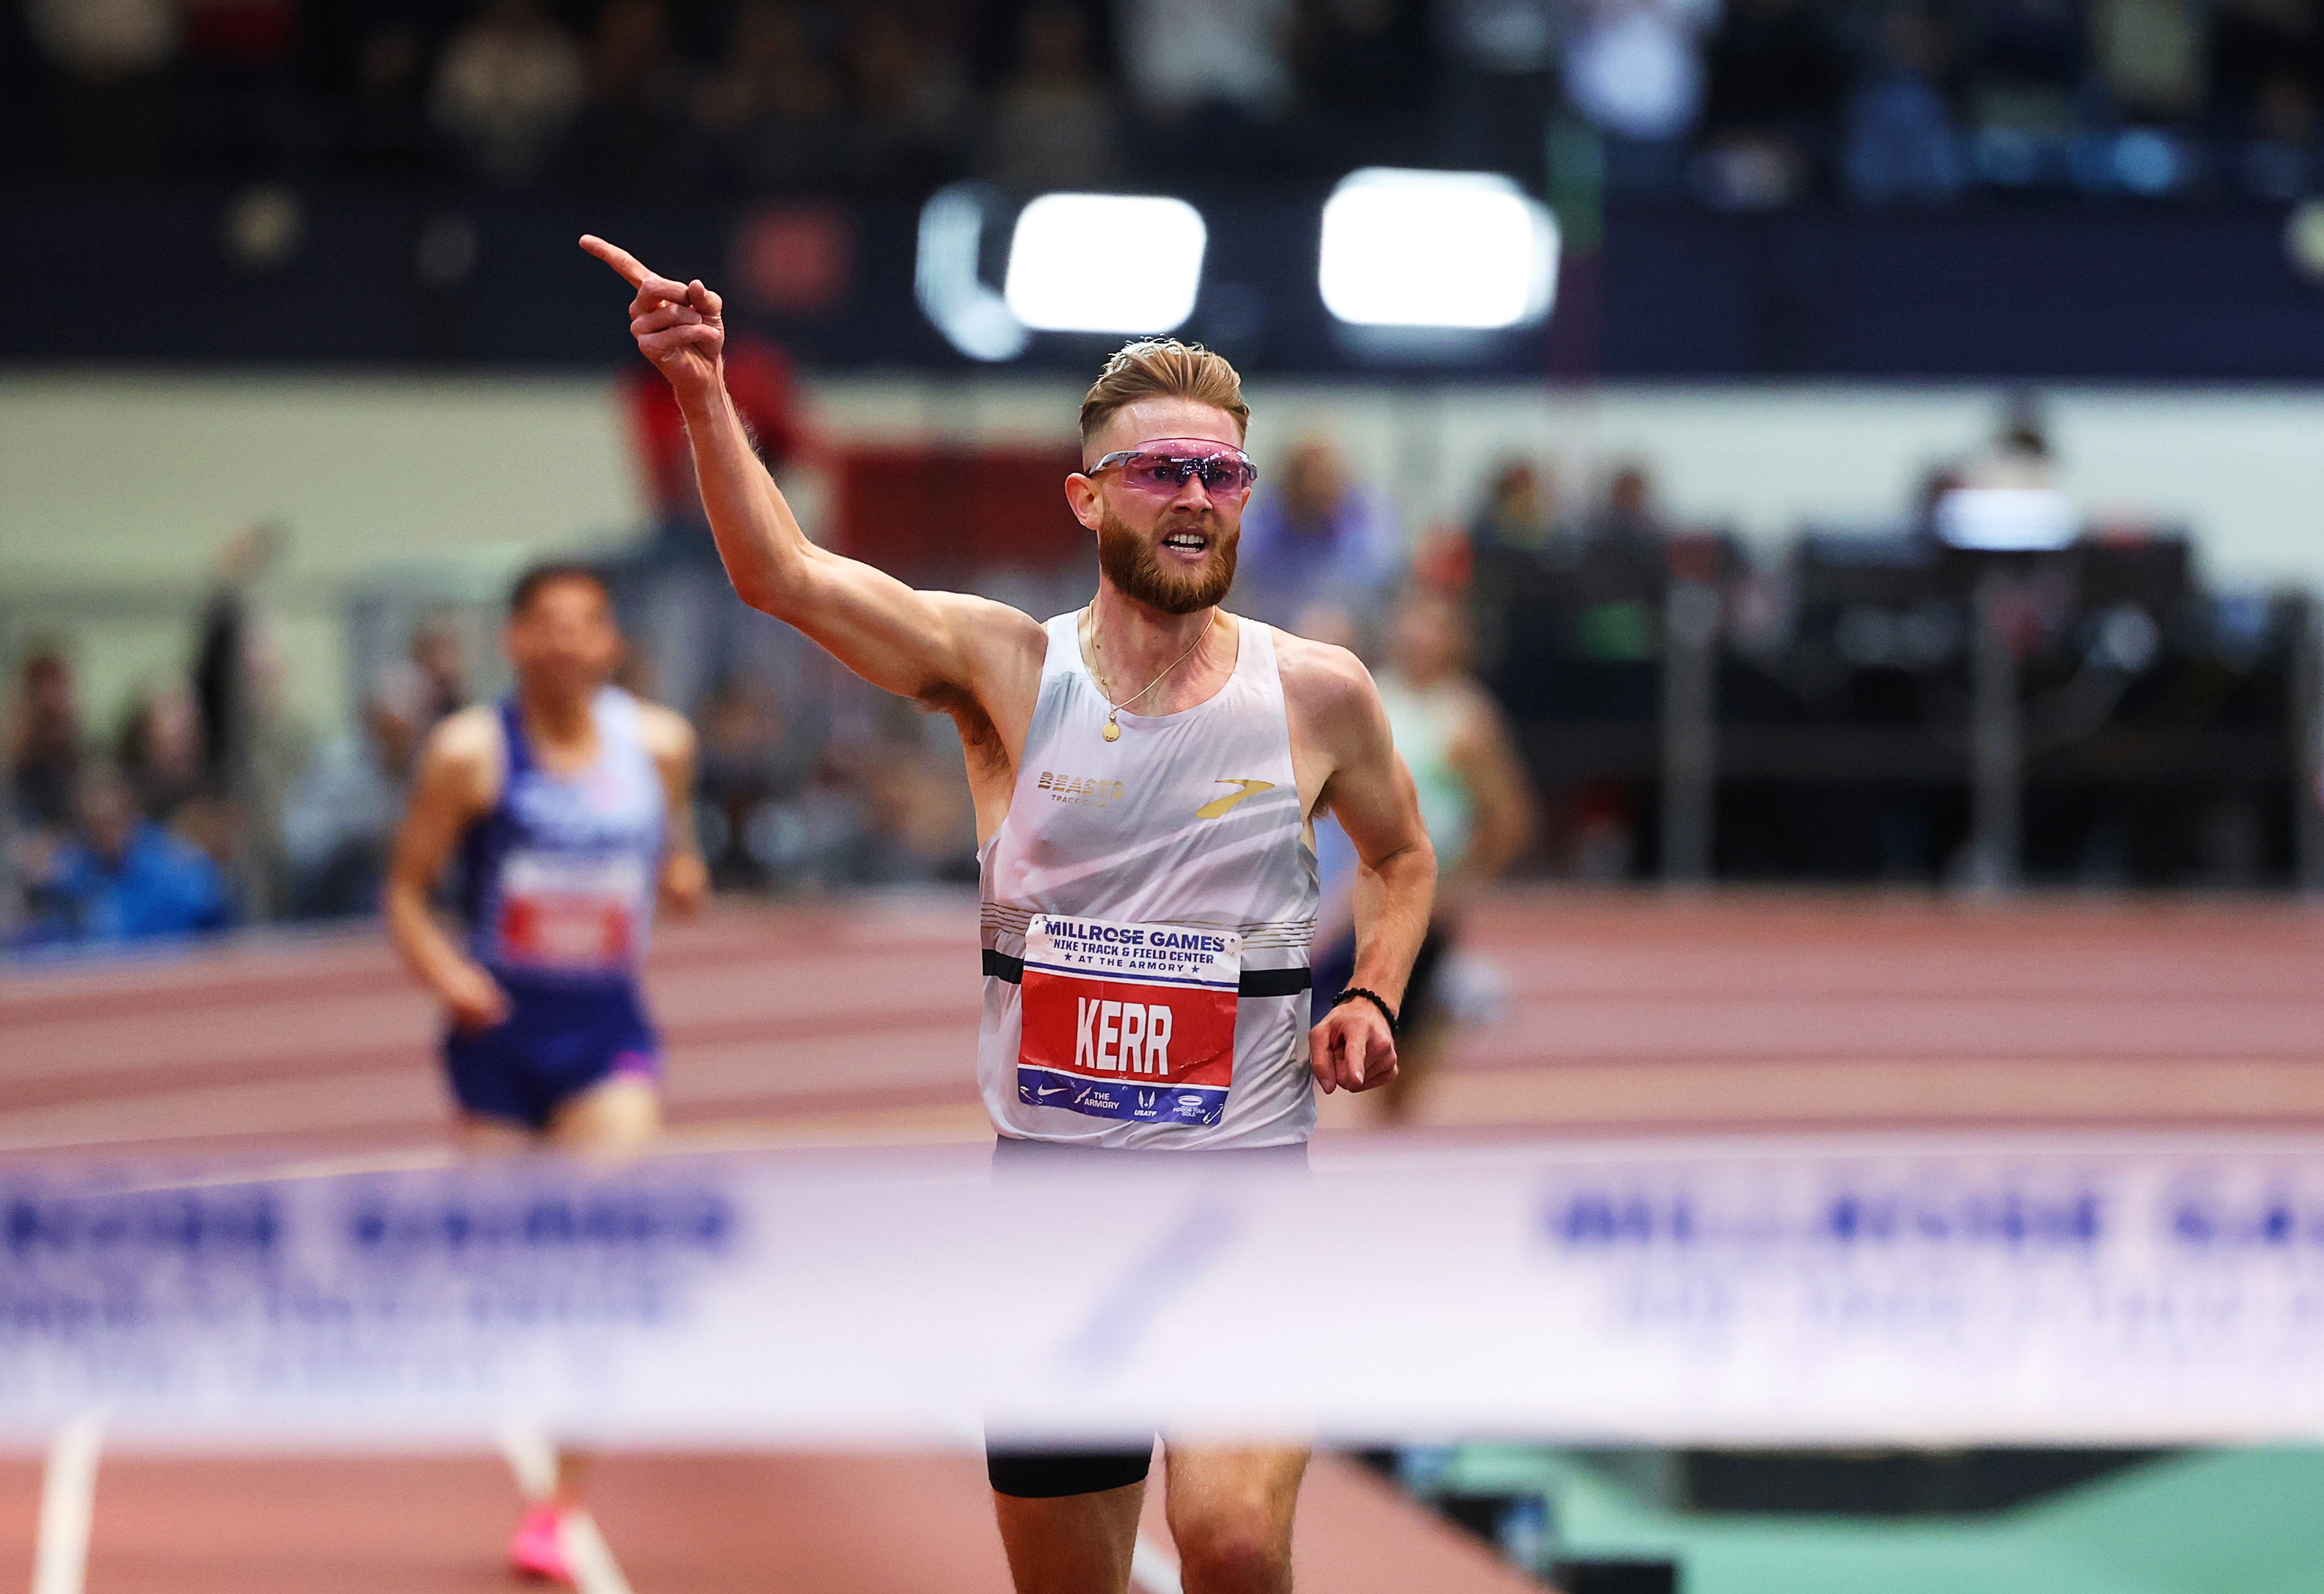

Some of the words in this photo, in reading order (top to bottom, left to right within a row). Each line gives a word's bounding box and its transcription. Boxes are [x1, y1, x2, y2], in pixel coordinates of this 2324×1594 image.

[1037, 771, 1124, 799] BEASTS
[1051, 794, 1080, 804] TRACK
[1045, 921, 1144, 945] MILLROSE
[1149, 931, 1225, 953] GAMES
[1053, 938, 1078, 952] NIKE
[1081, 942, 1119, 956] TRACK
[1121, 947, 1130, 957] &
[1133, 947, 1166, 960] FIELD
[1169, 950, 1214, 964] CENTER
[1078, 955, 1093, 964] AT
[1100, 957, 1123, 967] THE
[1129, 960, 1185, 972] ARMORY
[1074, 996, 1173, 1075] KERR
[1084, 1098, 1120, 1110] ARMORY
[1094, 1092, 1110, 1101] THE
